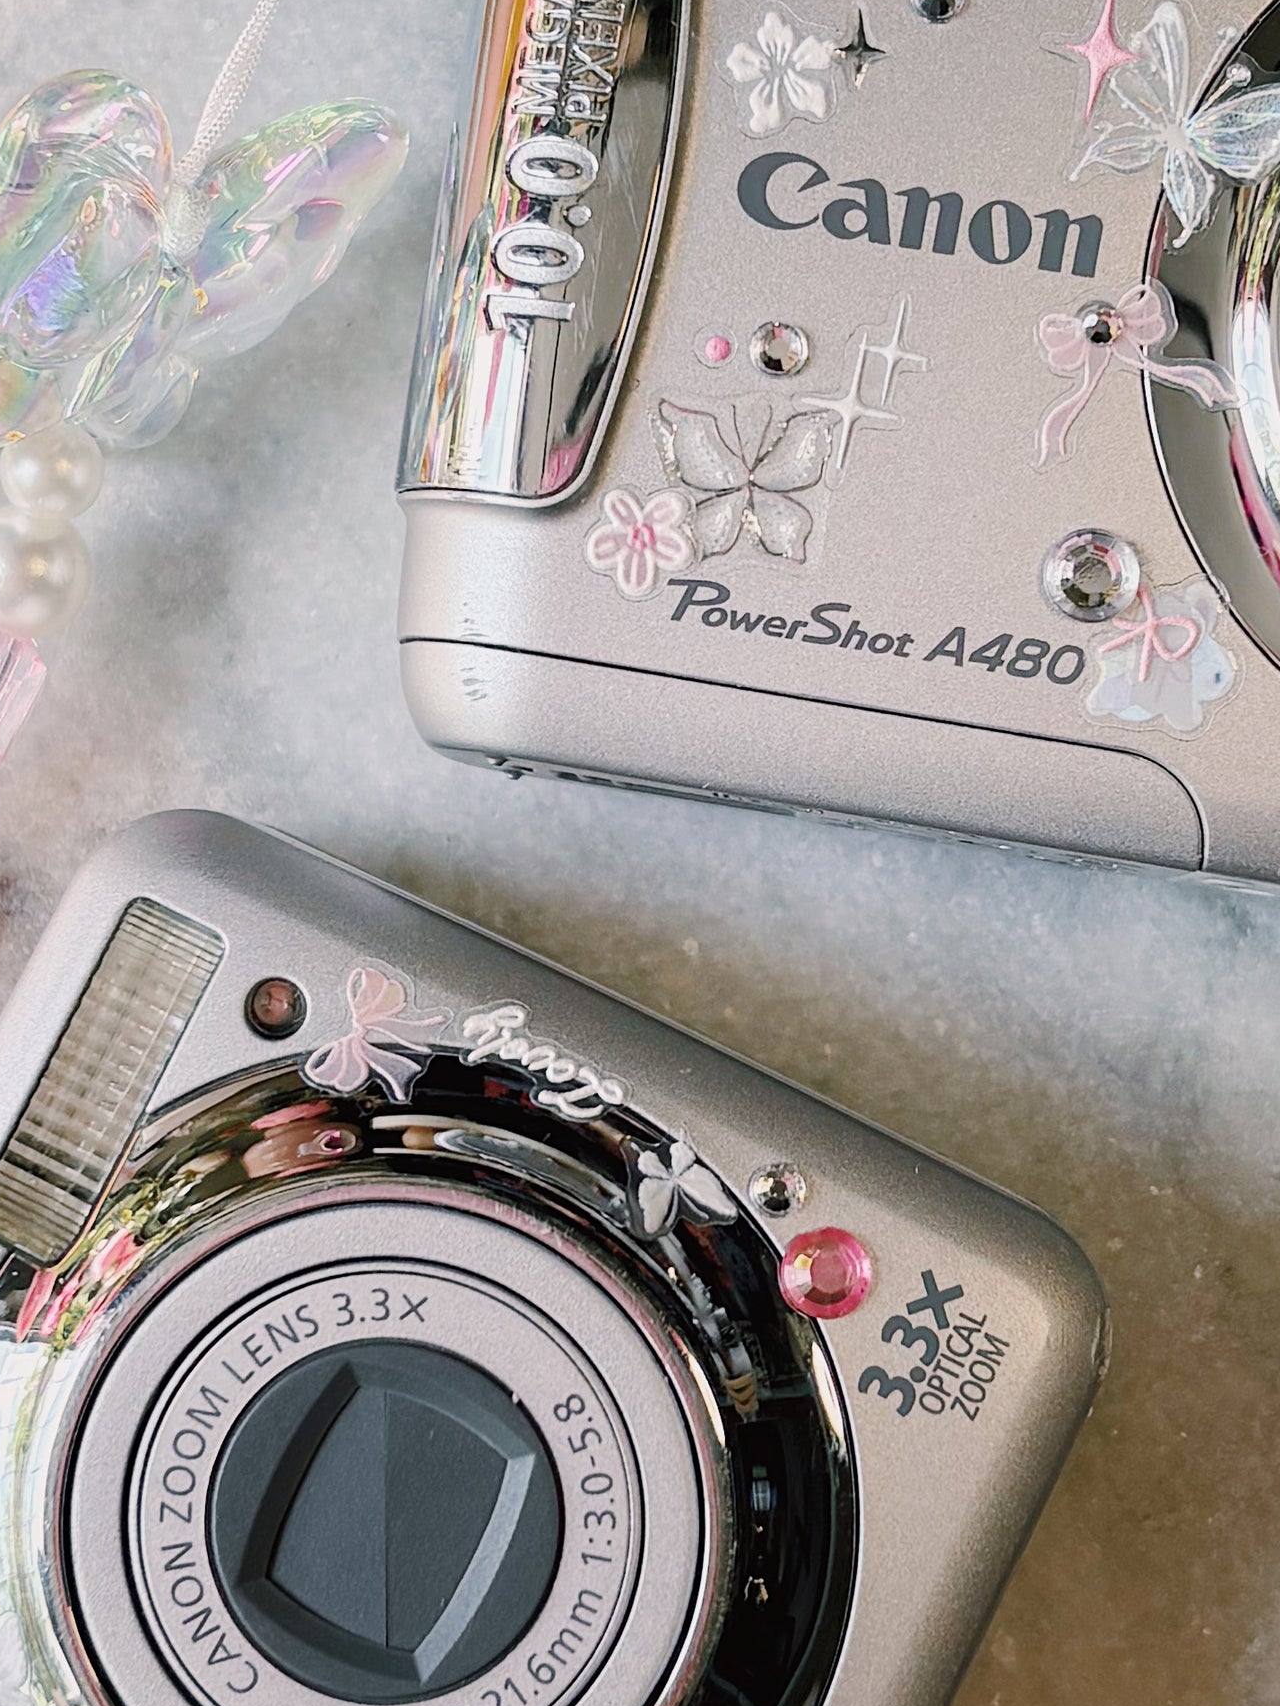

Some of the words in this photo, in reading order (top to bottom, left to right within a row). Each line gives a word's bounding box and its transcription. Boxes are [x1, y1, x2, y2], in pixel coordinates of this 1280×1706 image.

[484, 135, 600, 331] 10.0
[737, 151, 1104, 278] Canon
[667, 578, 915, 658] PowerShot
[923, 626, 1087, 685] A480
[463, 1005, 624, 1118] Lovely
[221, 1304, 320, 1384] LENS
[919, 1312, 987, 1414] OPTICAL
[950, 1332, 1010, 1421] ZOOM
[160, 1385, 229, 1524] ZOOM
[553, 1393, 617, 1565] 1:3.0-5.8
[160, 1541, 259, 1694] CANON
